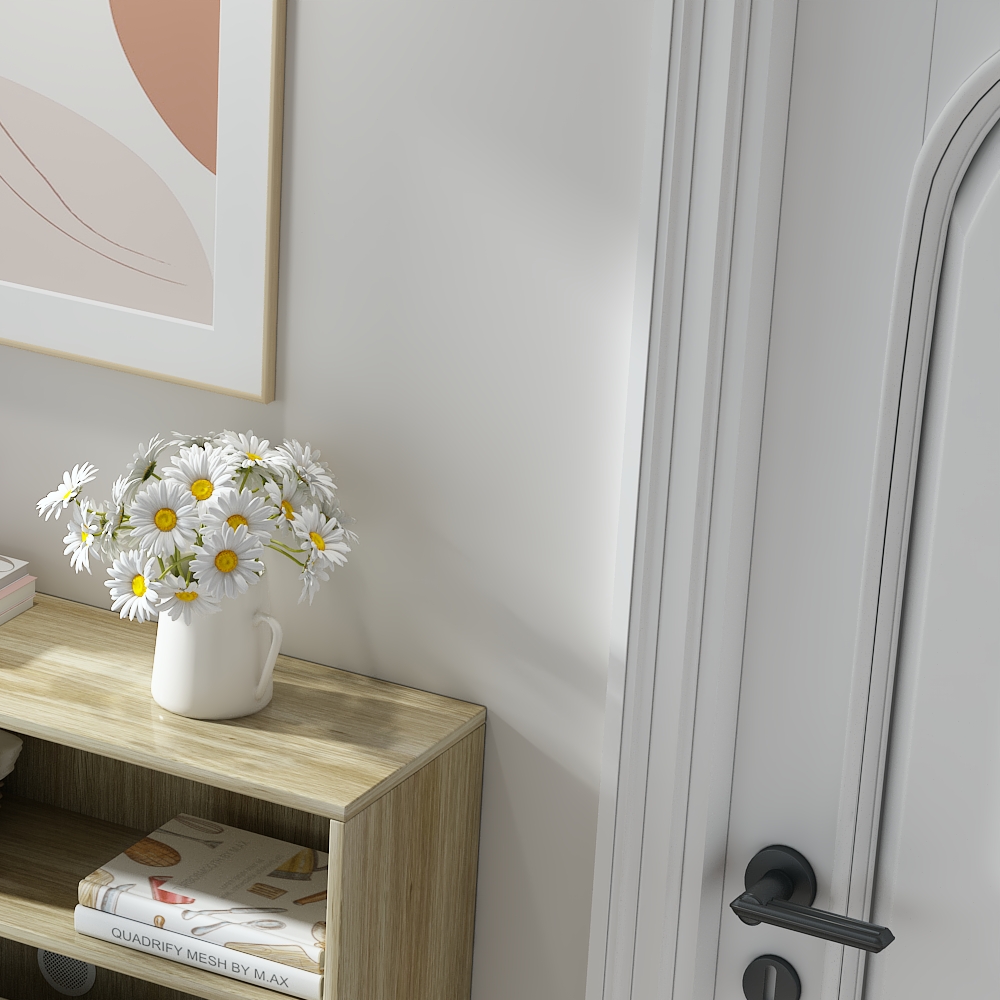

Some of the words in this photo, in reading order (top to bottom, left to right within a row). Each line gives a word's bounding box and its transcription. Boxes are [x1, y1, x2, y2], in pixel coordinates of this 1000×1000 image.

[111, 927, 183, 956] QUADRIFY
[186, 949, 227, 970] MESH
[231, 961, 250, 976] BY
[254, 968, 289, 988] M.AX
